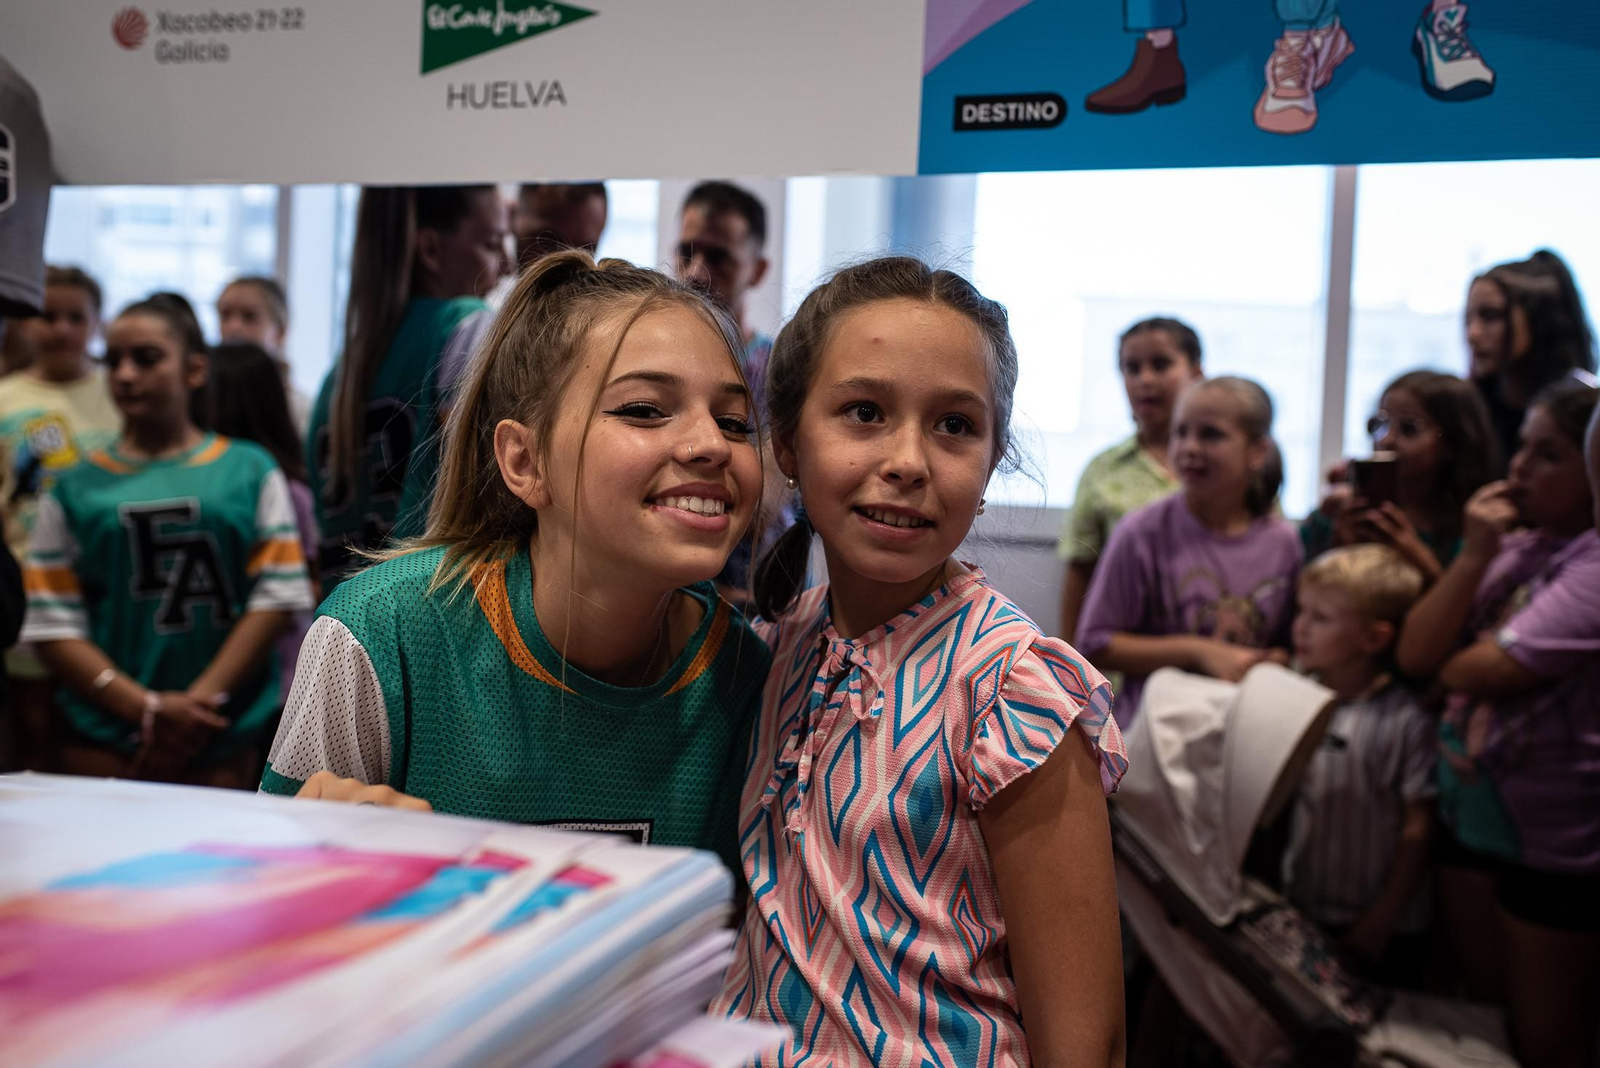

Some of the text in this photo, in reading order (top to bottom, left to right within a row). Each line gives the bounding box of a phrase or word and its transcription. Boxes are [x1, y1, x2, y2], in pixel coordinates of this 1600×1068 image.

[155, 9, 253, 33] Xacobeo
[154, 39, 230, 64] Galicia
[447, 80, 567, 109] HUELVA
[961, 100, 1059, 123] DESTINO
